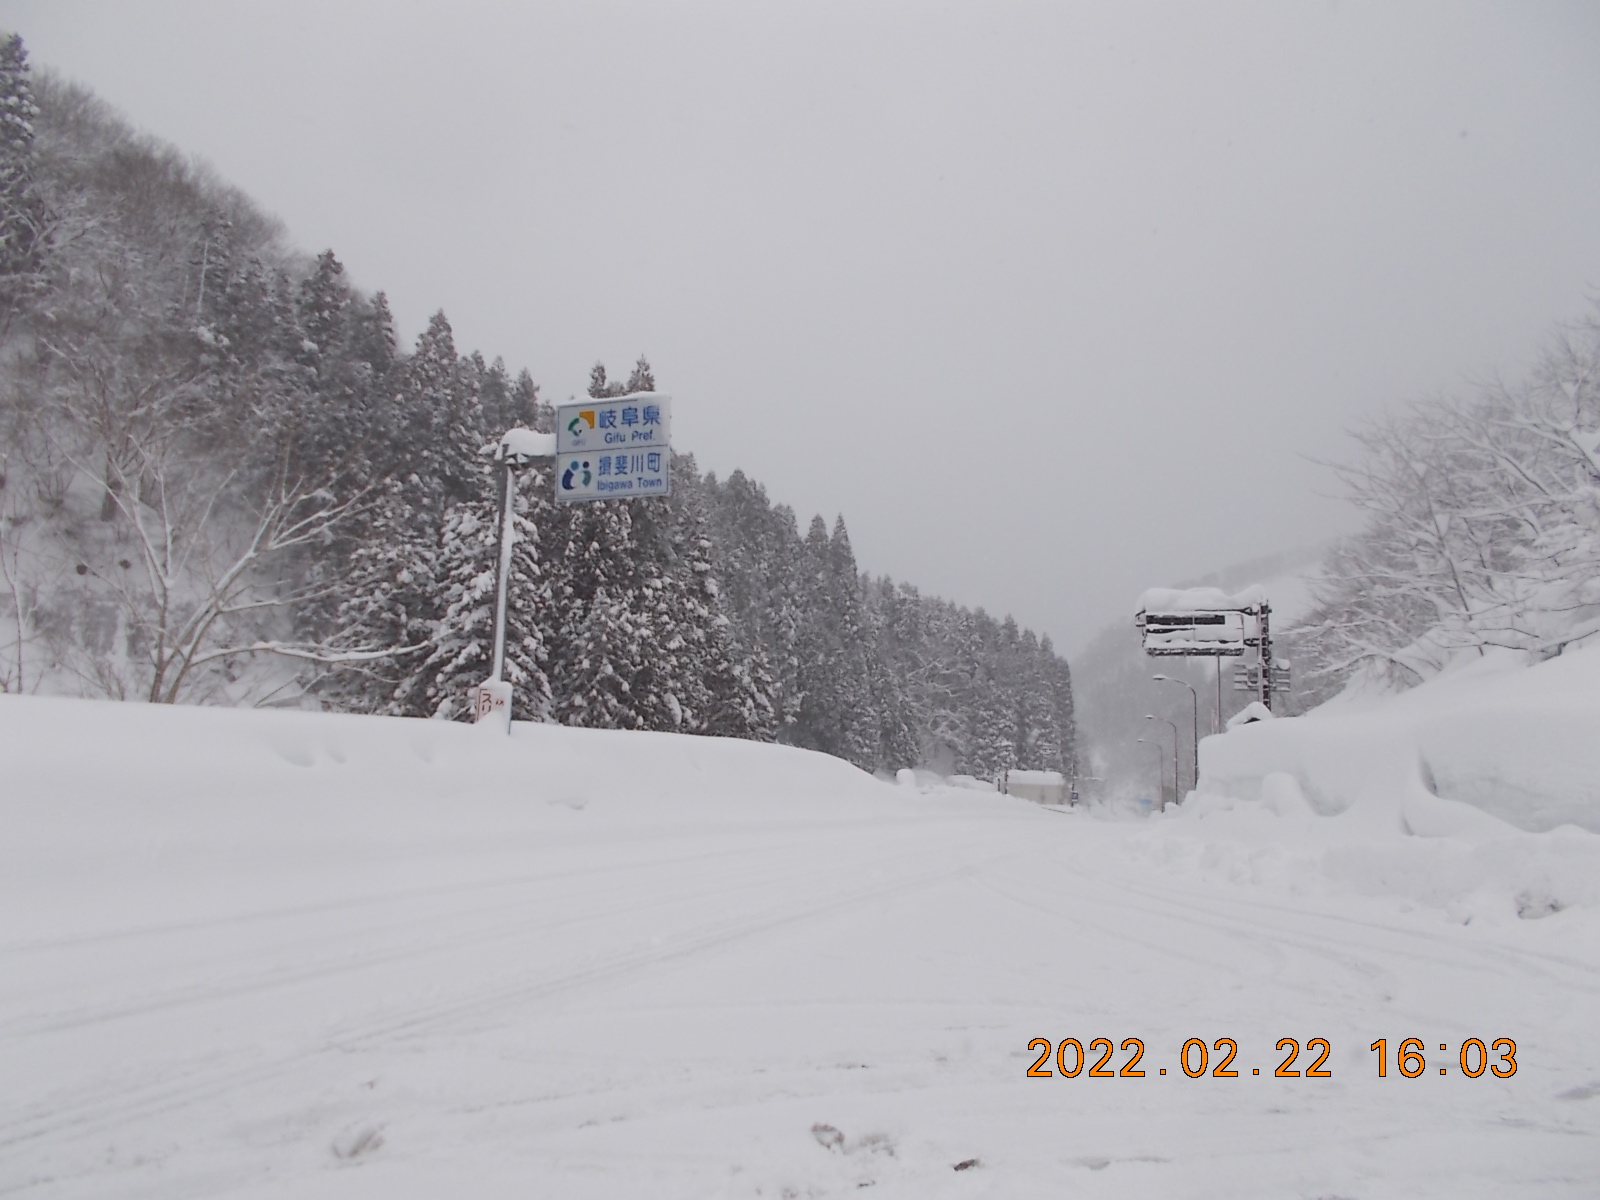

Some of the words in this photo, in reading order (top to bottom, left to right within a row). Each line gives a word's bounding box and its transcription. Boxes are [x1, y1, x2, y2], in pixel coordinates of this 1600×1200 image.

[599, 405, 661, 429] 岐阜県
[604, 432, 626, 444] Gifu
[598, 452, 661, 476] 揖斐川町
[596, 479, 633, 492] Ibigawa
[637, 476, 662, 488] Town
